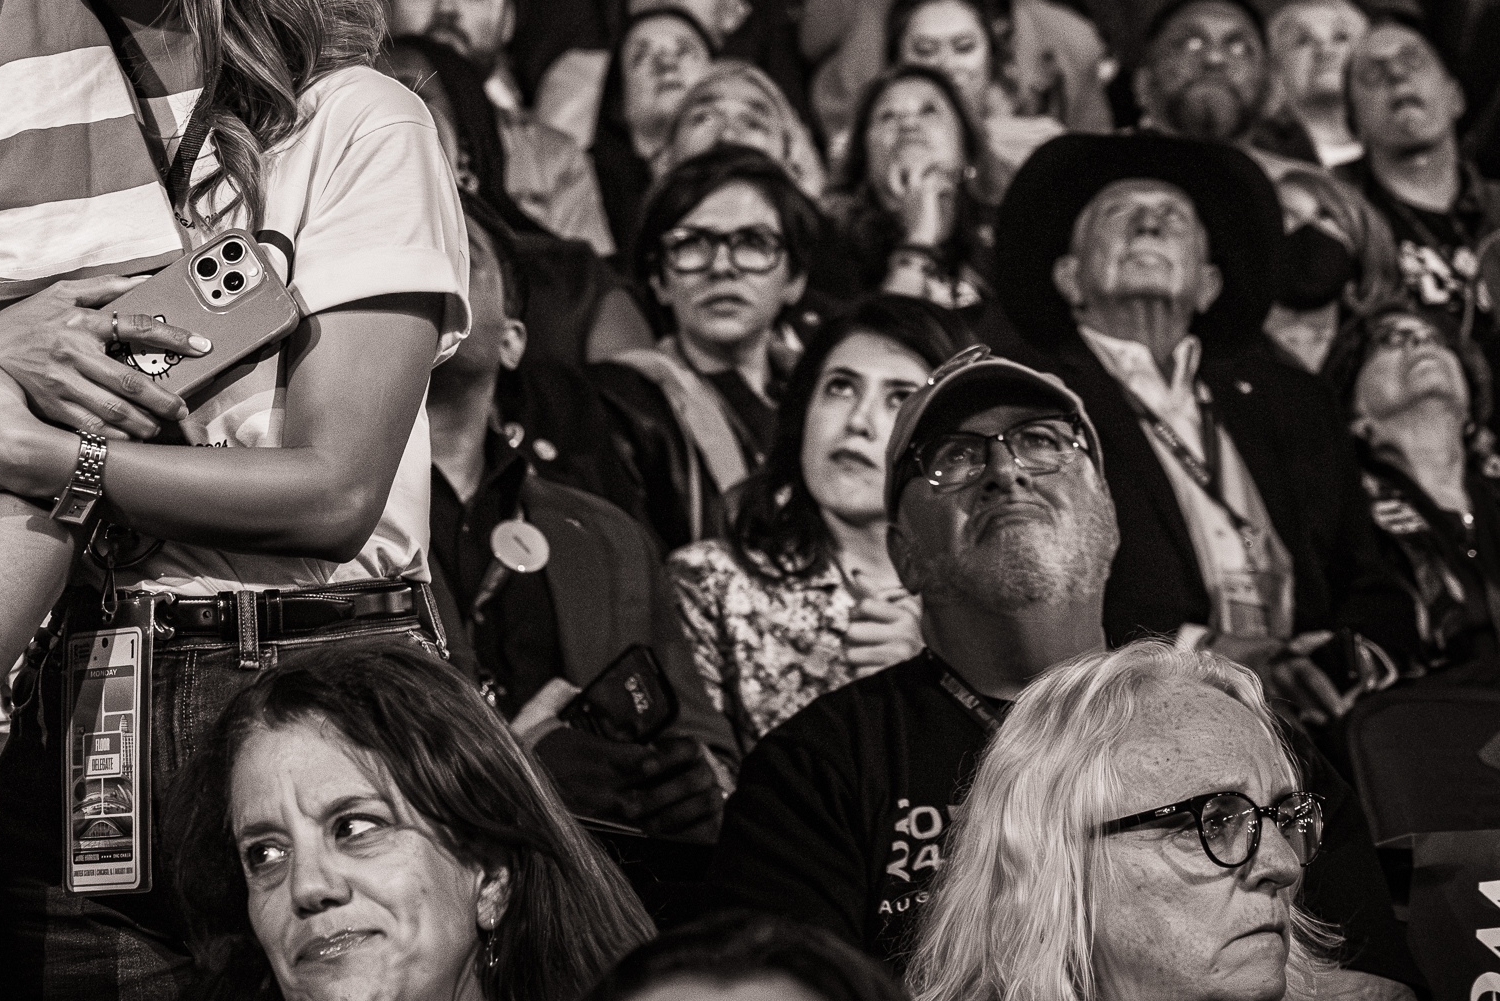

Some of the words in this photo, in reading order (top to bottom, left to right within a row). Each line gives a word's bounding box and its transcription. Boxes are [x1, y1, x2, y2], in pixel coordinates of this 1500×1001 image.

[130, 638, 135, 659] 1
[90, 668, 118, 679] MONDAY
[95, 737, 110, 752] FLOOR
[91, 757, 114, 772] DELEGATE
[886, 840, 946, 883] 24
[877, 891, 931, 915] AUG
